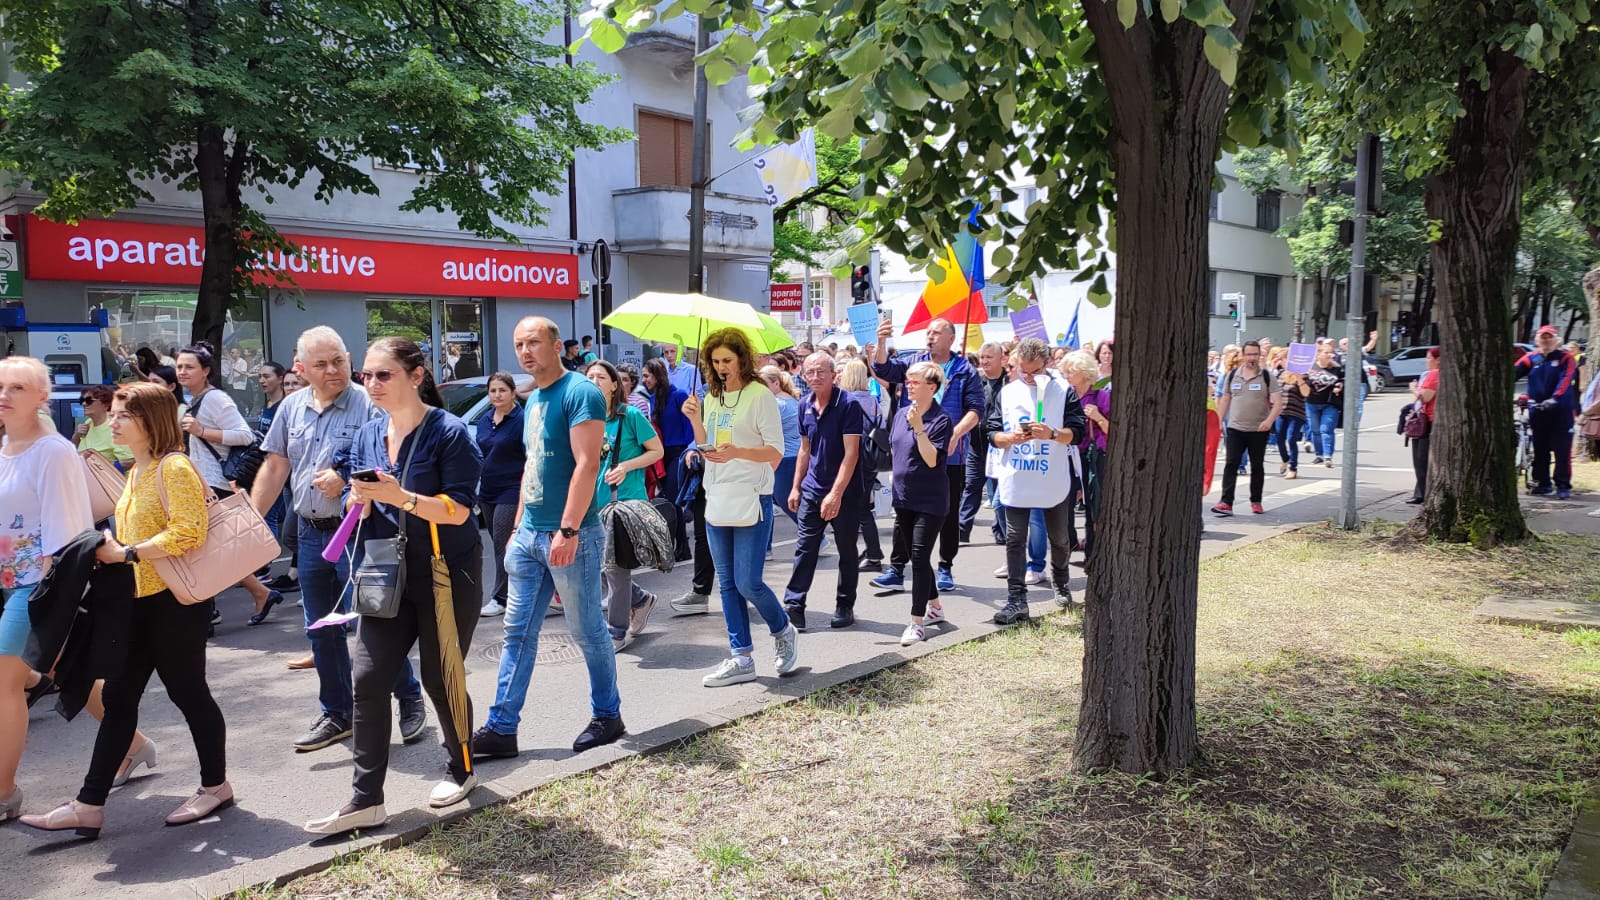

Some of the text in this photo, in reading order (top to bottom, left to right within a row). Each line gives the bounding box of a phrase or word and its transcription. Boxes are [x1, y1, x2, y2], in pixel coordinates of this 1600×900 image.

[68, 236, 207, 270] aparat
[442, 257, 570, 286] audionova
[771, 298, 802, 307] auditive
[772, 289, 802, 299] aparate
[1011, 458, 1049, 475] TIMIȘ
